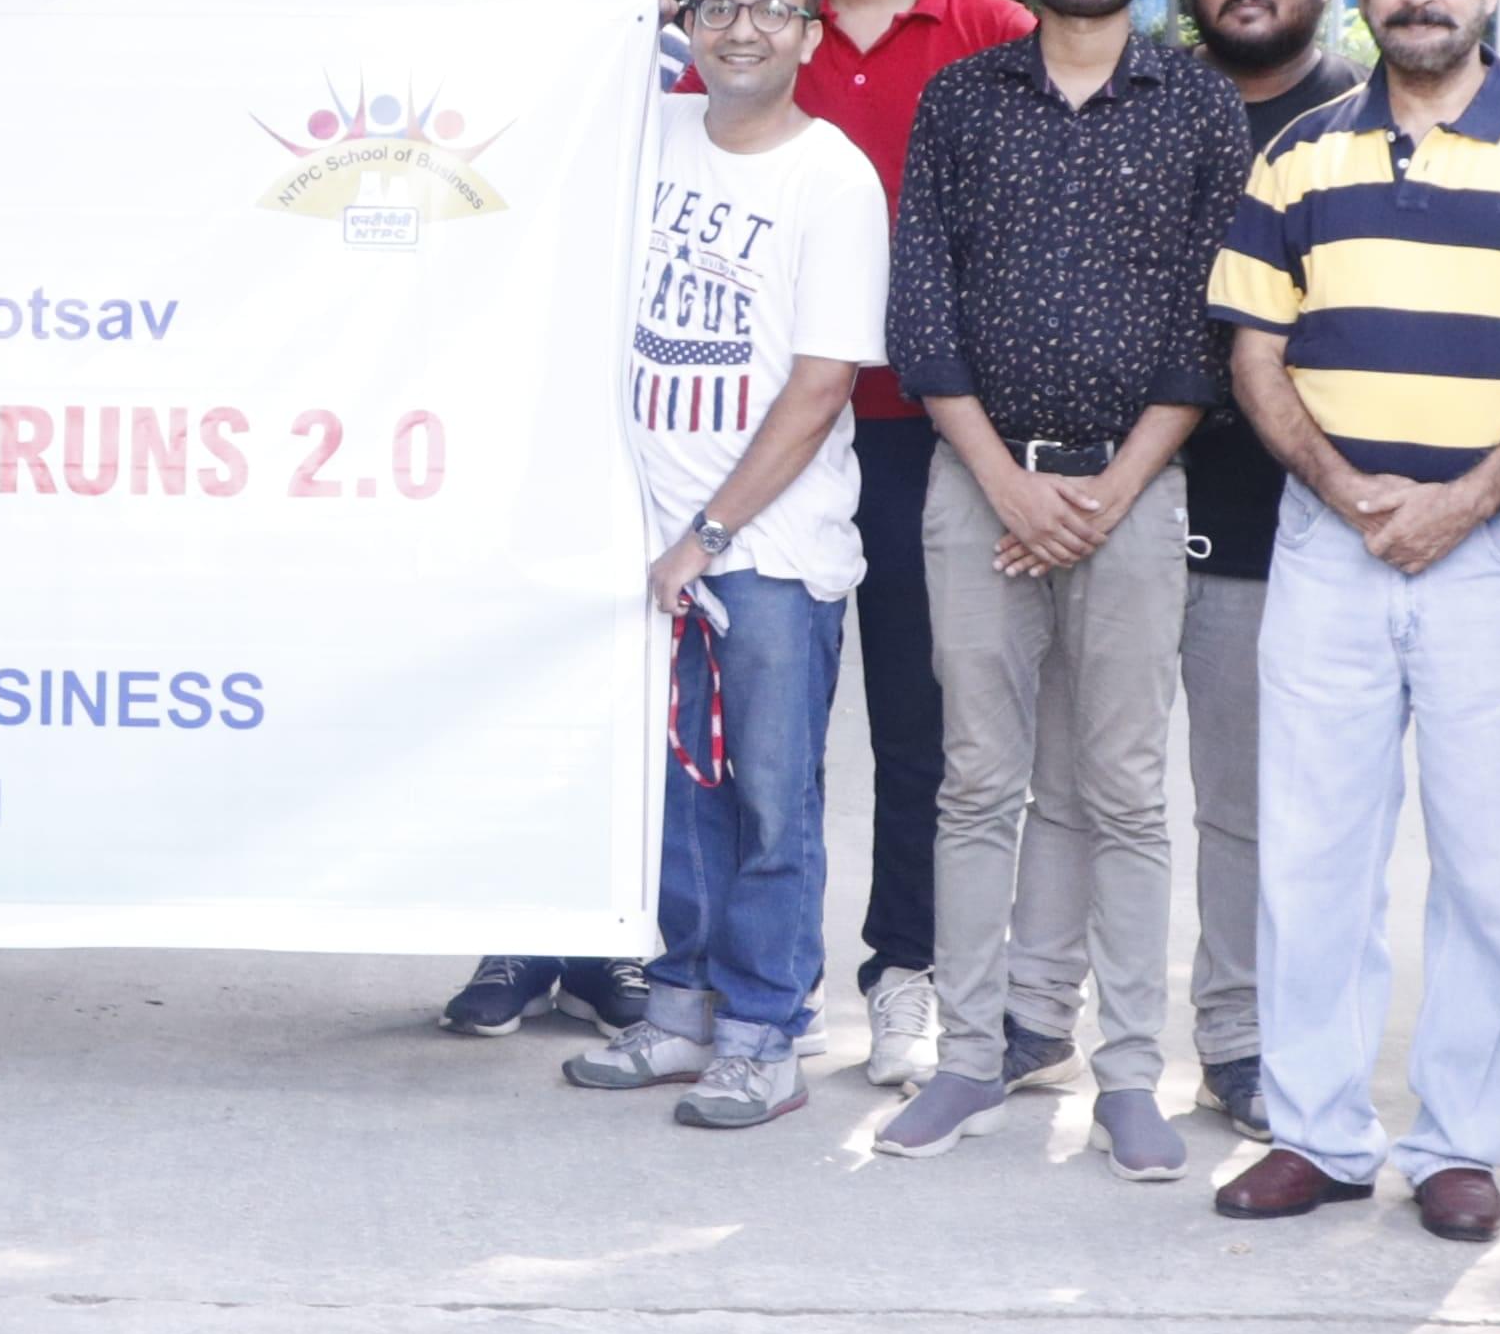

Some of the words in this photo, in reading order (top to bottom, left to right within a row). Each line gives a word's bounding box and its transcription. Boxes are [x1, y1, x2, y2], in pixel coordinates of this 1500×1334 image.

[278, 165, 323, 207] NTPC
[325, 146, 389, 172] School
[394, 147, 413, 163] of
[415, 152, 485, 210] Business
[638, 259, 753, 337] AGUE
[288, 408, 448, 500] 2.0
